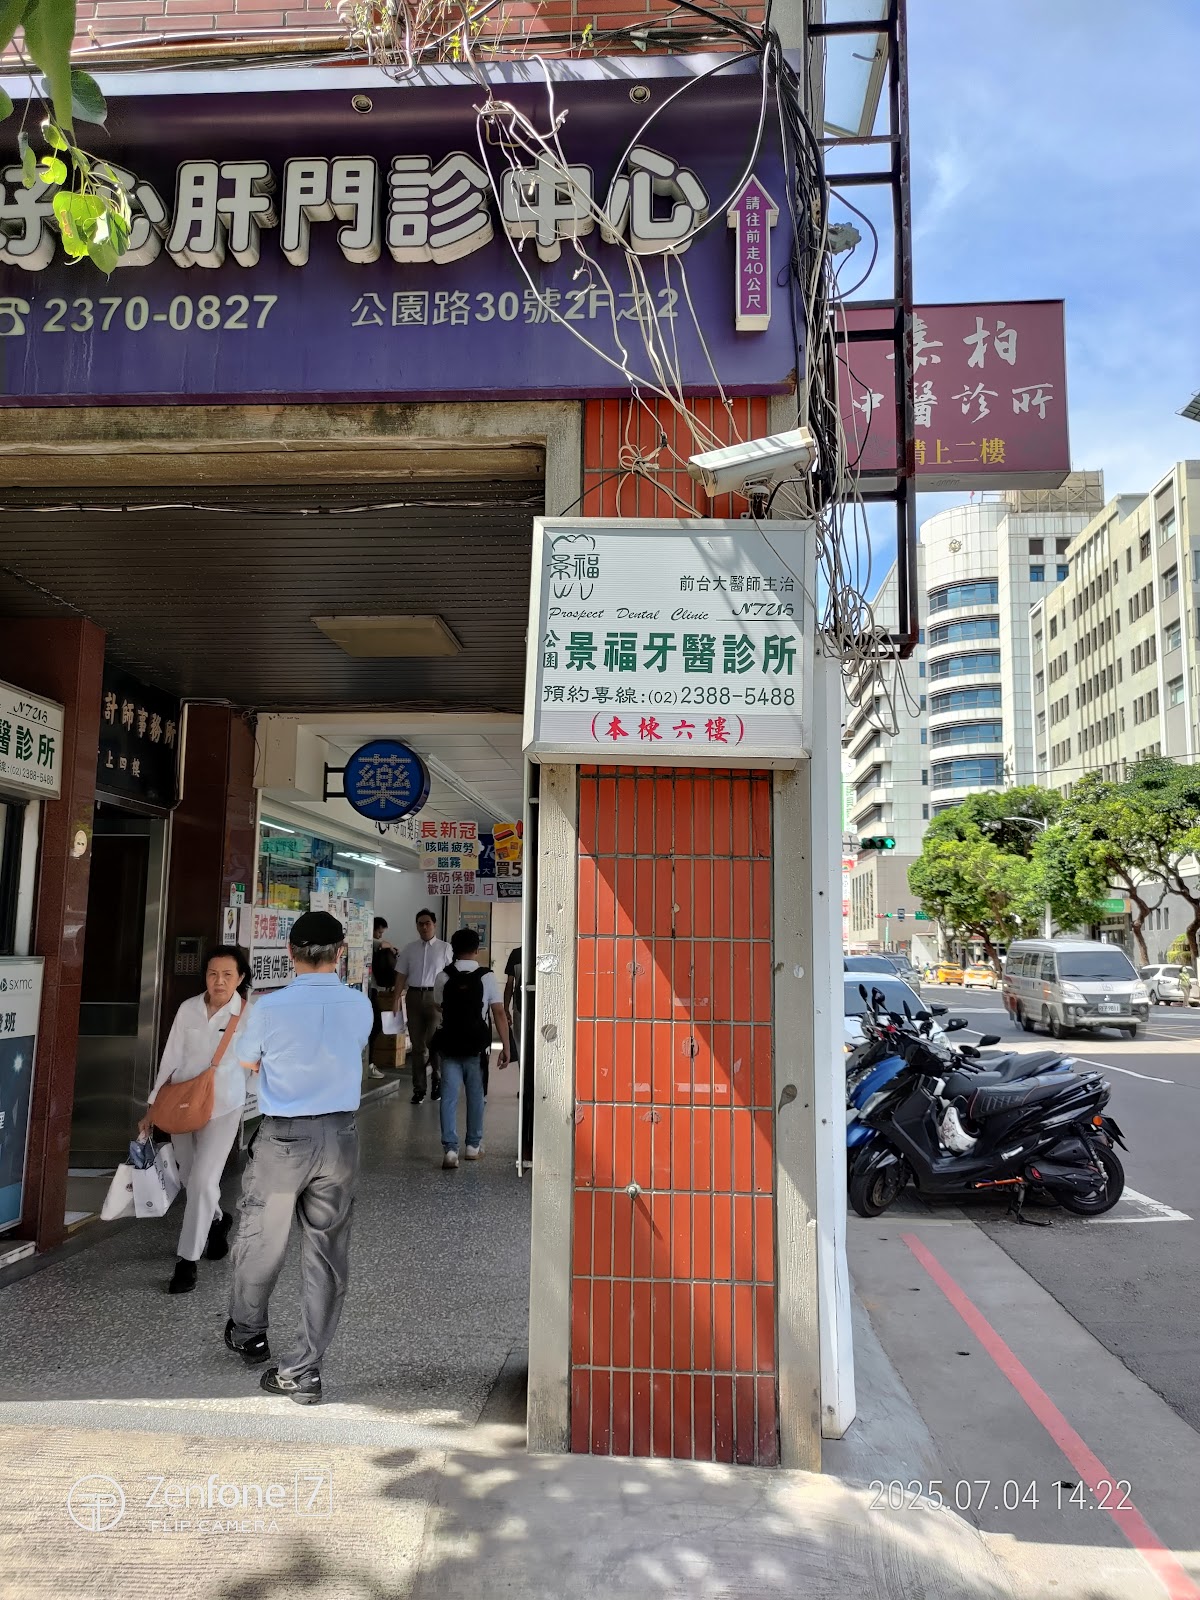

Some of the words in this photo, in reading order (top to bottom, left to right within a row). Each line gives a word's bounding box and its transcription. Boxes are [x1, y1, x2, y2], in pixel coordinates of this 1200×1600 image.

[744, 196, 763, 308] 請往前走40公尺
[43, 294, 278, 332] 2370-0827
[350, 288, 679, 328] 公園路30號2F之2
[680, 575, 795, 592] 前台大醫師主治
[548, 607, 604, 620] Prospect
[616, 607, 660, 620] Dental
[670, 607, 709, 621] Clinic
[542, 629, 560, 670] 公園
[565, 631, 797, 675] 景福牙醫診所
[355, 753, 412, 809] 藥
[421, 821, 477, 839] 長新冠
[427, 871, 475, 883] 預防保健
